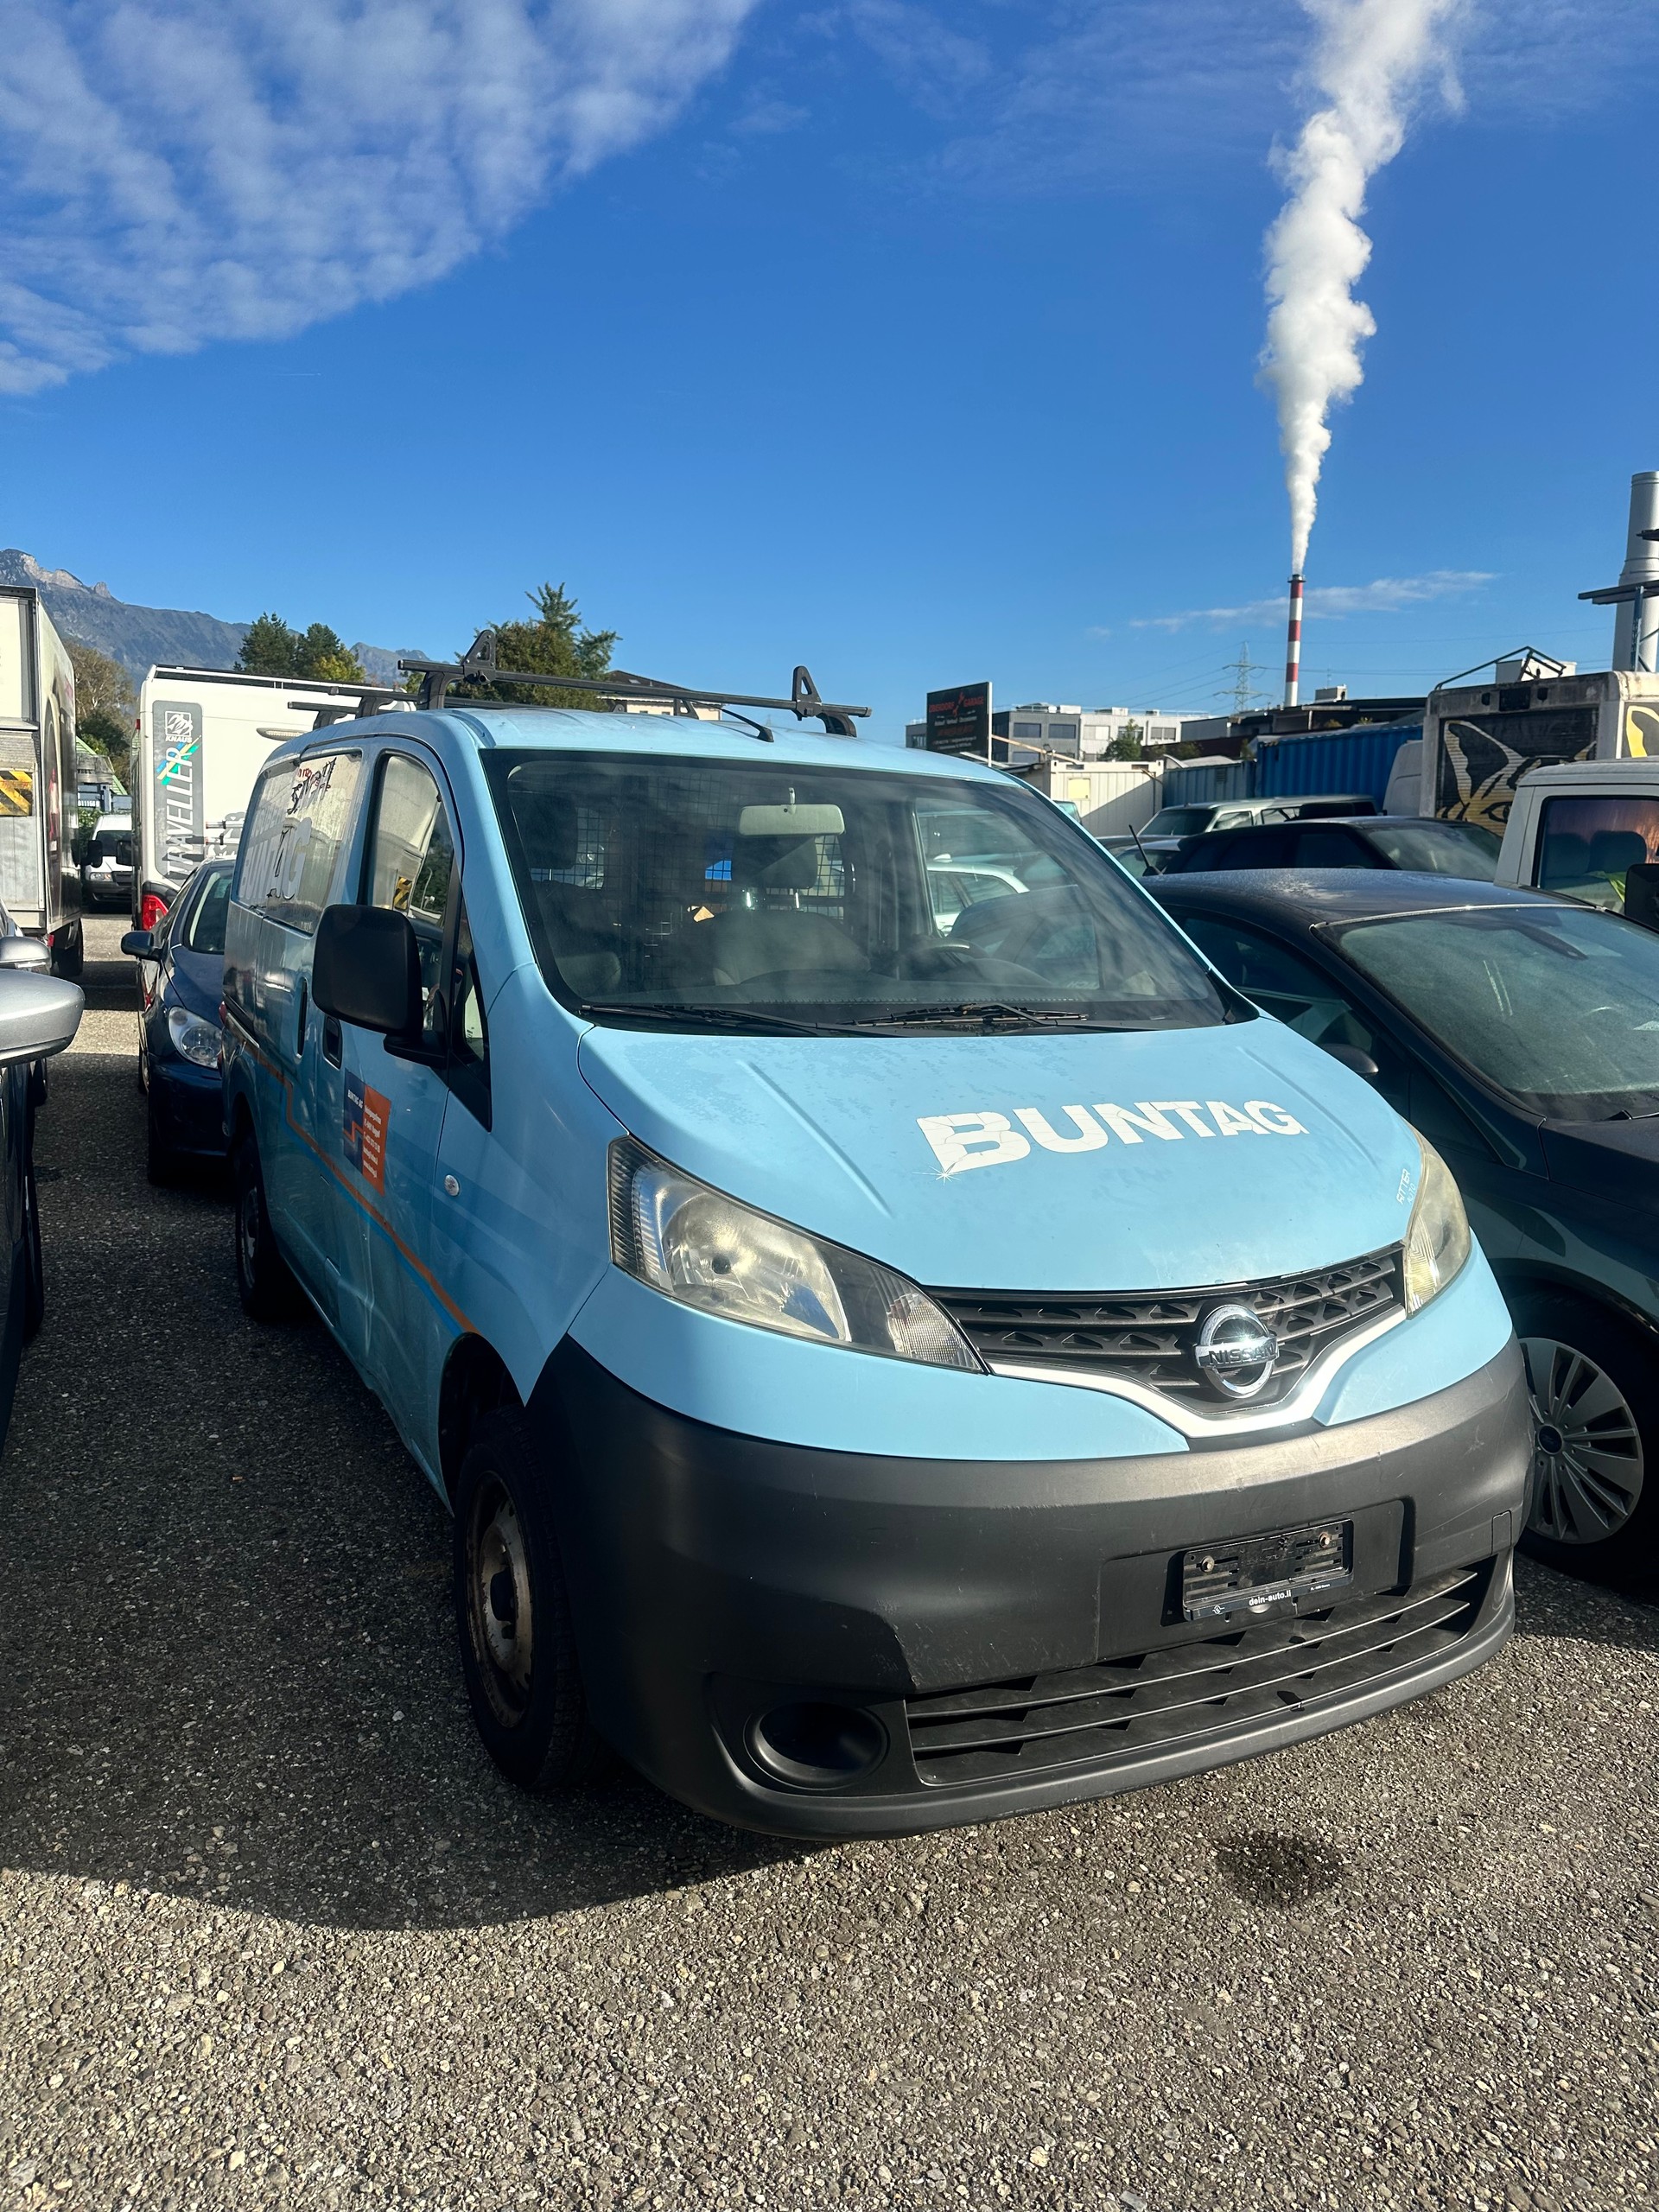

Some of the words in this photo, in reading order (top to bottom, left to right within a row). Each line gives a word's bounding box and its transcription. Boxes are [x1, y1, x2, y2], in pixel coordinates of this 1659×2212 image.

[165, 734, 193, 743] KNAUS
[165, 747, 194, 876] TRAVELLER
[918, 1099, 1311, 1175] BUNTAG
[1396, 1168, 1410, 1205] RITTER
[1407, 1183, 1416, 1205] AUTO
[1208, 1343, 1275, 1365] NISSAN
[1249, 1590, 1292, 1606] dein-auto.li
